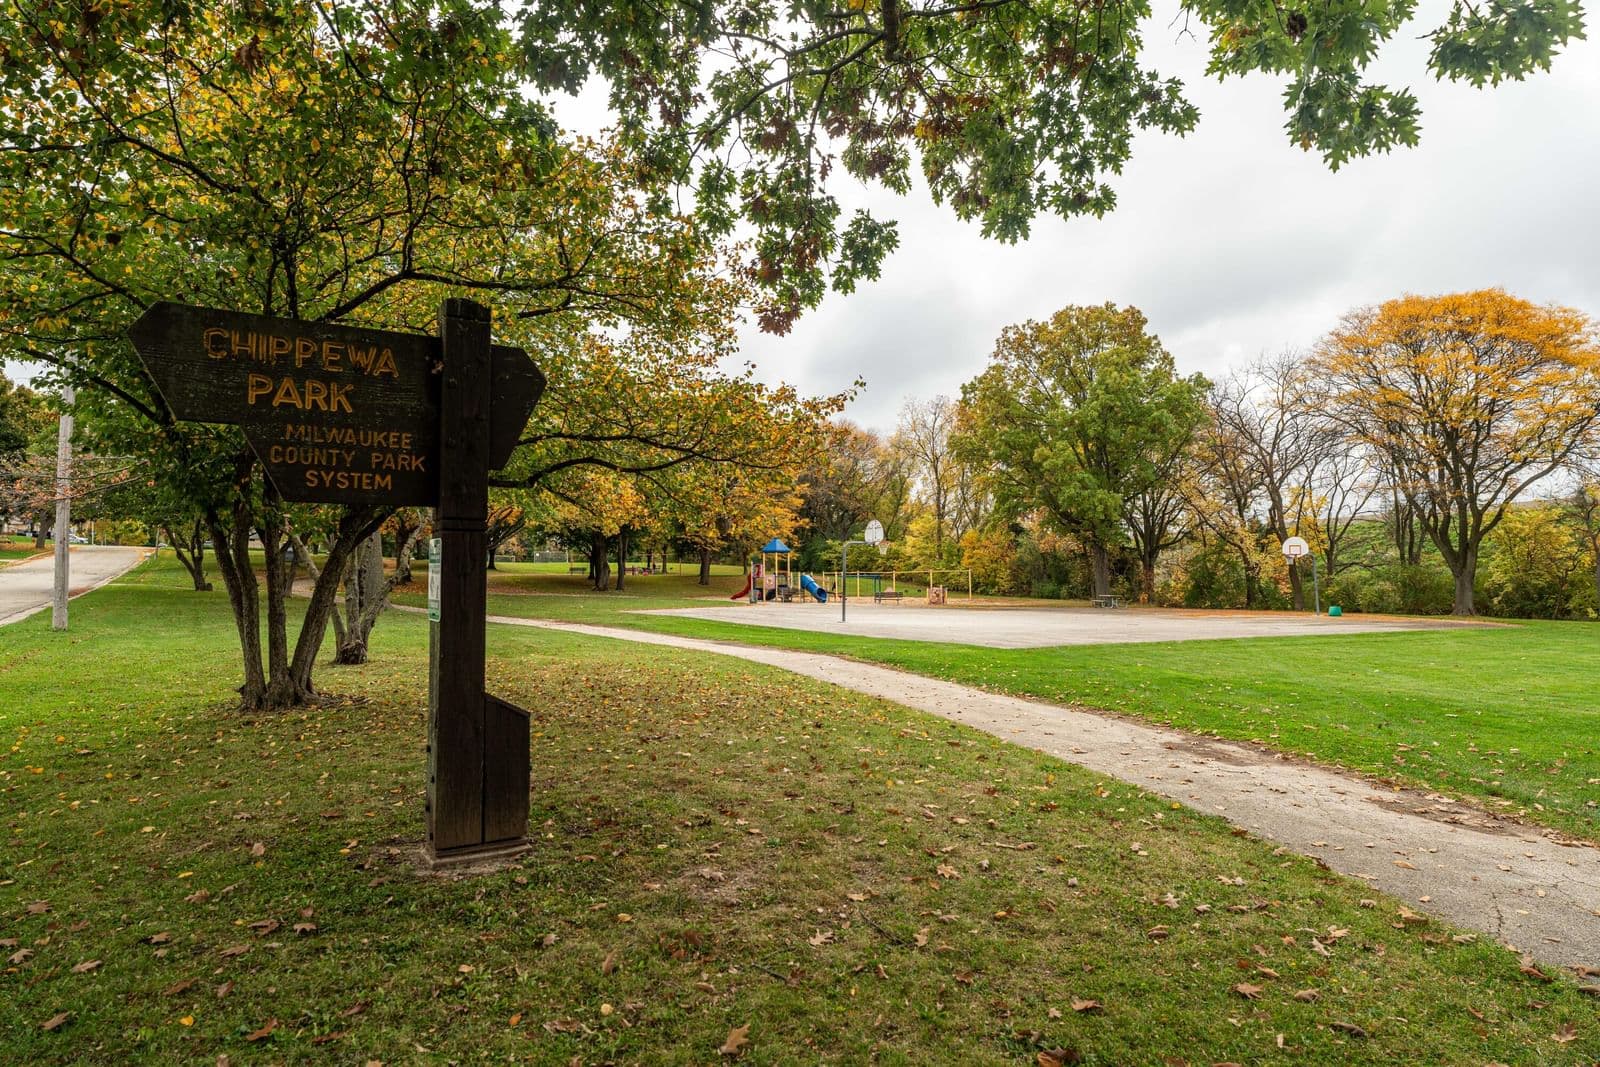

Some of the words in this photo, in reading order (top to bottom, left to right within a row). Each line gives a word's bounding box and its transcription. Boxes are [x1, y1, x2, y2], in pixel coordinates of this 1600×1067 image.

[203, 327, 399, 378] CHIPPEWA
[247, 373, 354, 413] PARK
[285, 423, 412, 449] MILWAUKEE
[270, 445, 356, 466] COUNTY
[371, 452, 426, 472] PARK
[305, 470, 392, 491] SYSTEM
